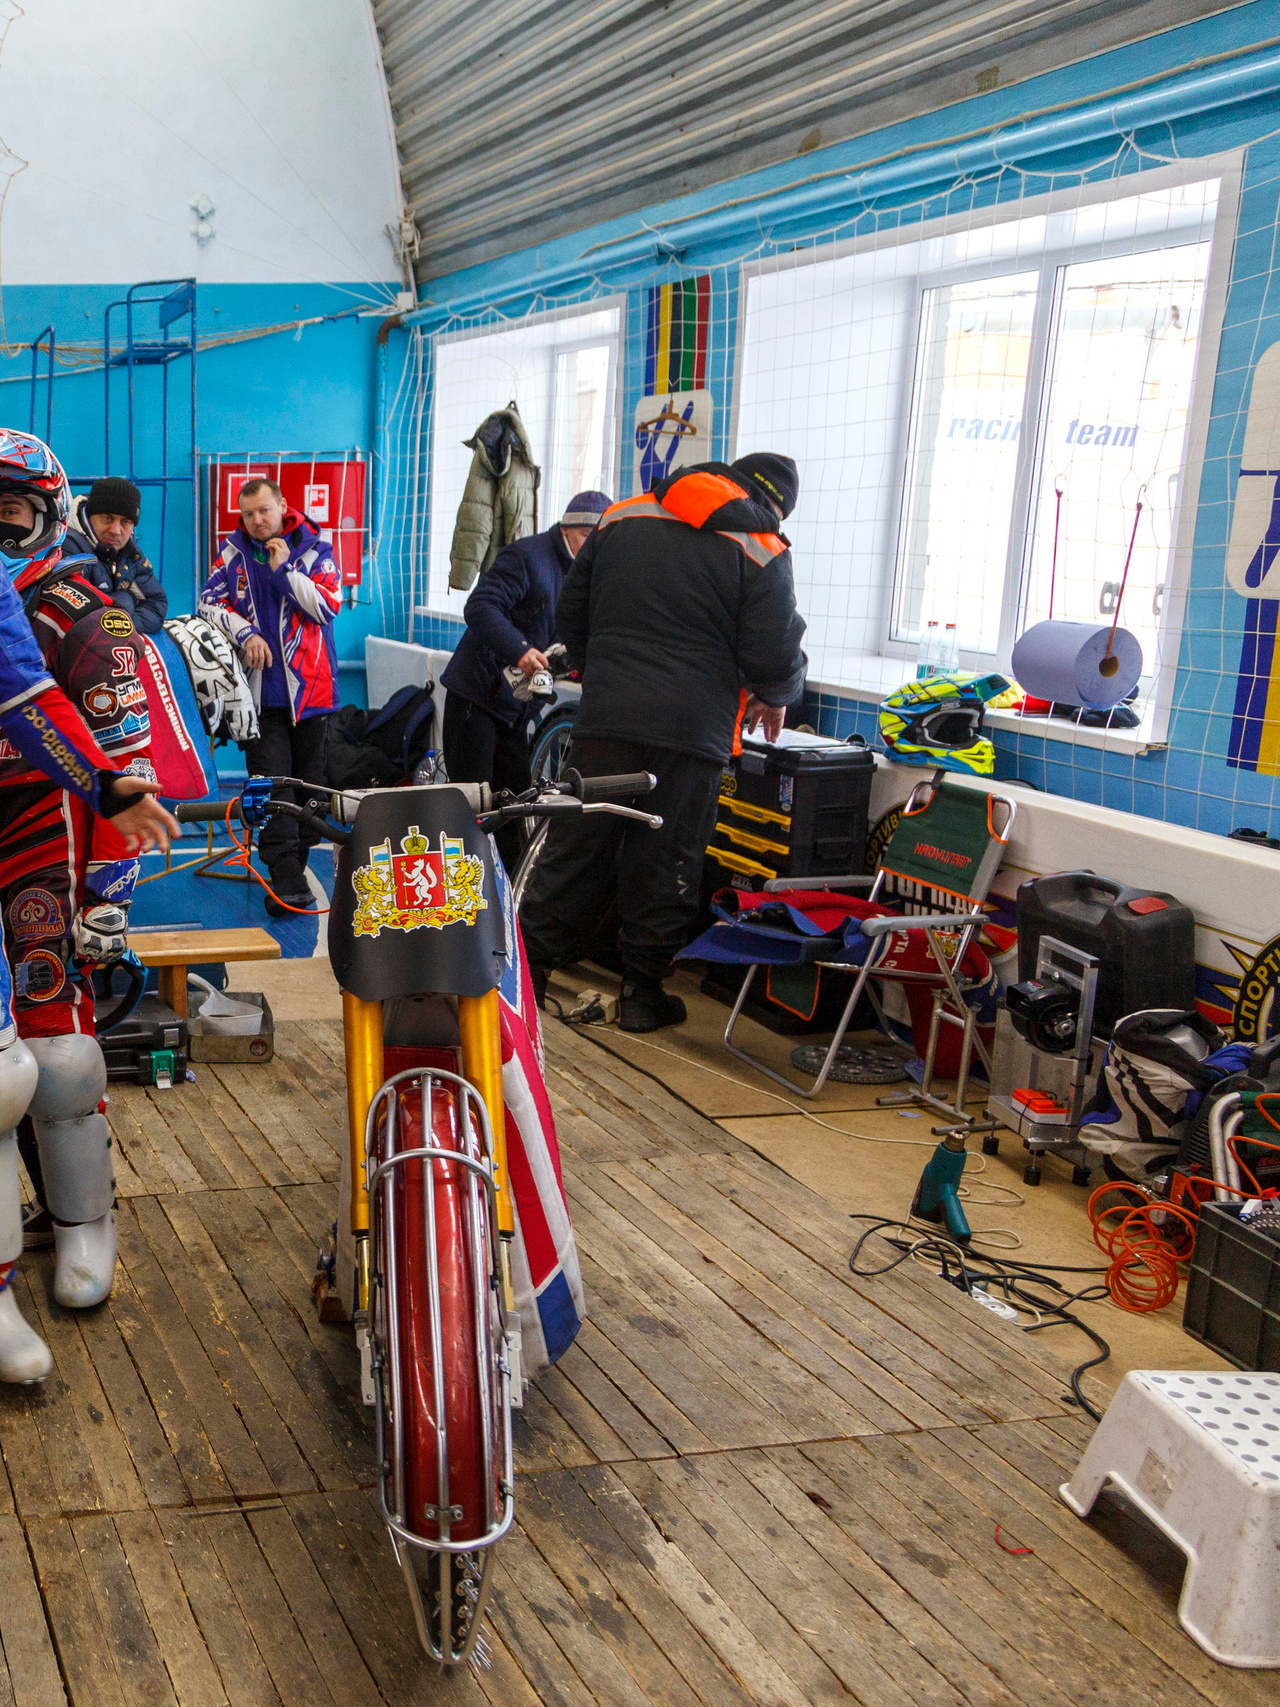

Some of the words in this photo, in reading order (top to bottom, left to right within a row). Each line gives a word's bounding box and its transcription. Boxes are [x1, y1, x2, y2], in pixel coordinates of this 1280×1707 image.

[1065, 420, 1139, 447] team
[104, 619, 131, 629] OSO
[1239, 947, 1280, 1035] СПОРТ
